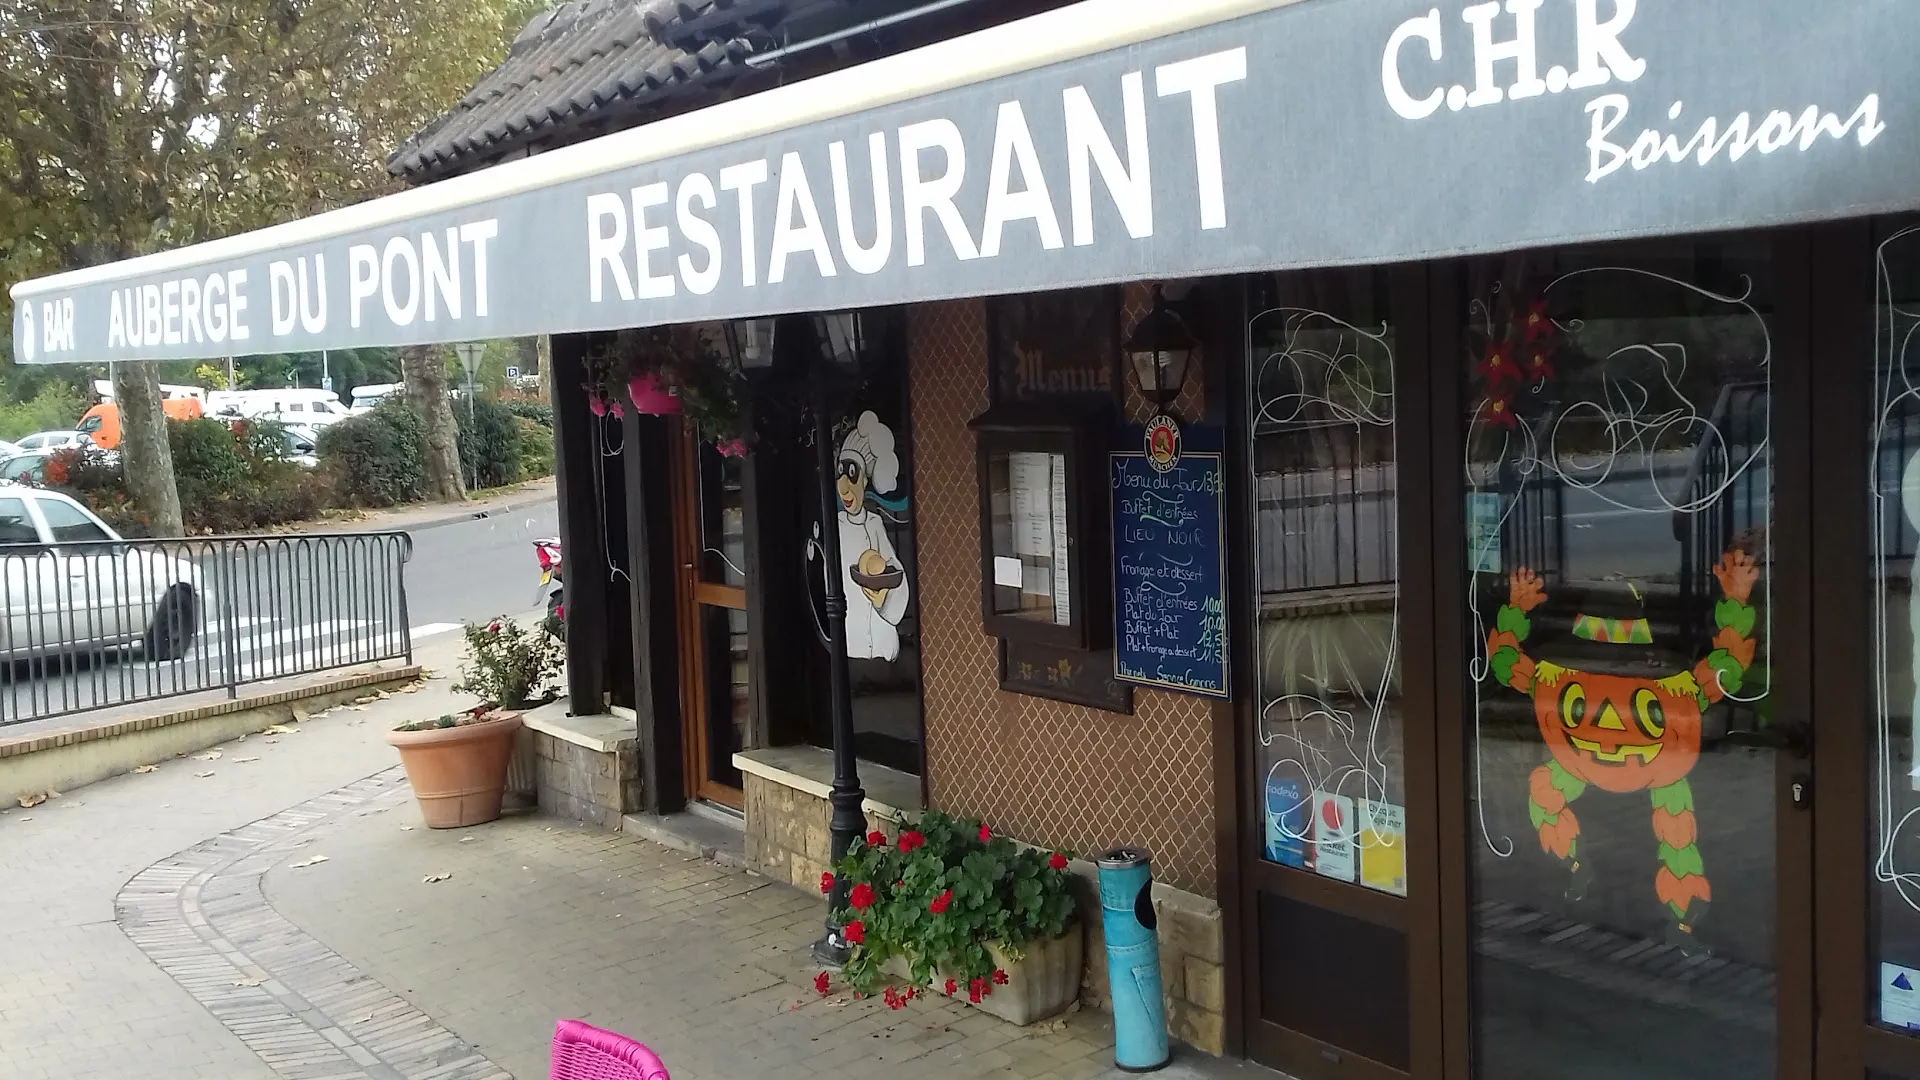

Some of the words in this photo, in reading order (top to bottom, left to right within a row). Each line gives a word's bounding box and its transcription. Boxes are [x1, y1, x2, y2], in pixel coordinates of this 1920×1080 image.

[1382, 0, 1646, 120] C.H.R
[1584, 94, 1885, 184] Boissons
[44, 298, 75, 352] BAR
[108, 269, 249, 348] AUBERGE
[269, 253, 327, 336] DU
[349, 218, 498, 329] PONT
[587, 46, 1247, 303] RESTAURANT
[1015, 341, 1112, 395] Menus
[1111, 458, 1150, 489] Menu
[1152, 471, 1170, 489] du
[1125, 524, 1155, 544] LIEU
[1168, 527, 1206, 547] NOIR
[1157, 562, 1170, 578] et
[1123, 587, 1154, 606] Buffet
[1125, 603, 1145, 620] Plat
[1144, 605, 1157, 621] du
[1124, 619, 1153, 635] Buffet
